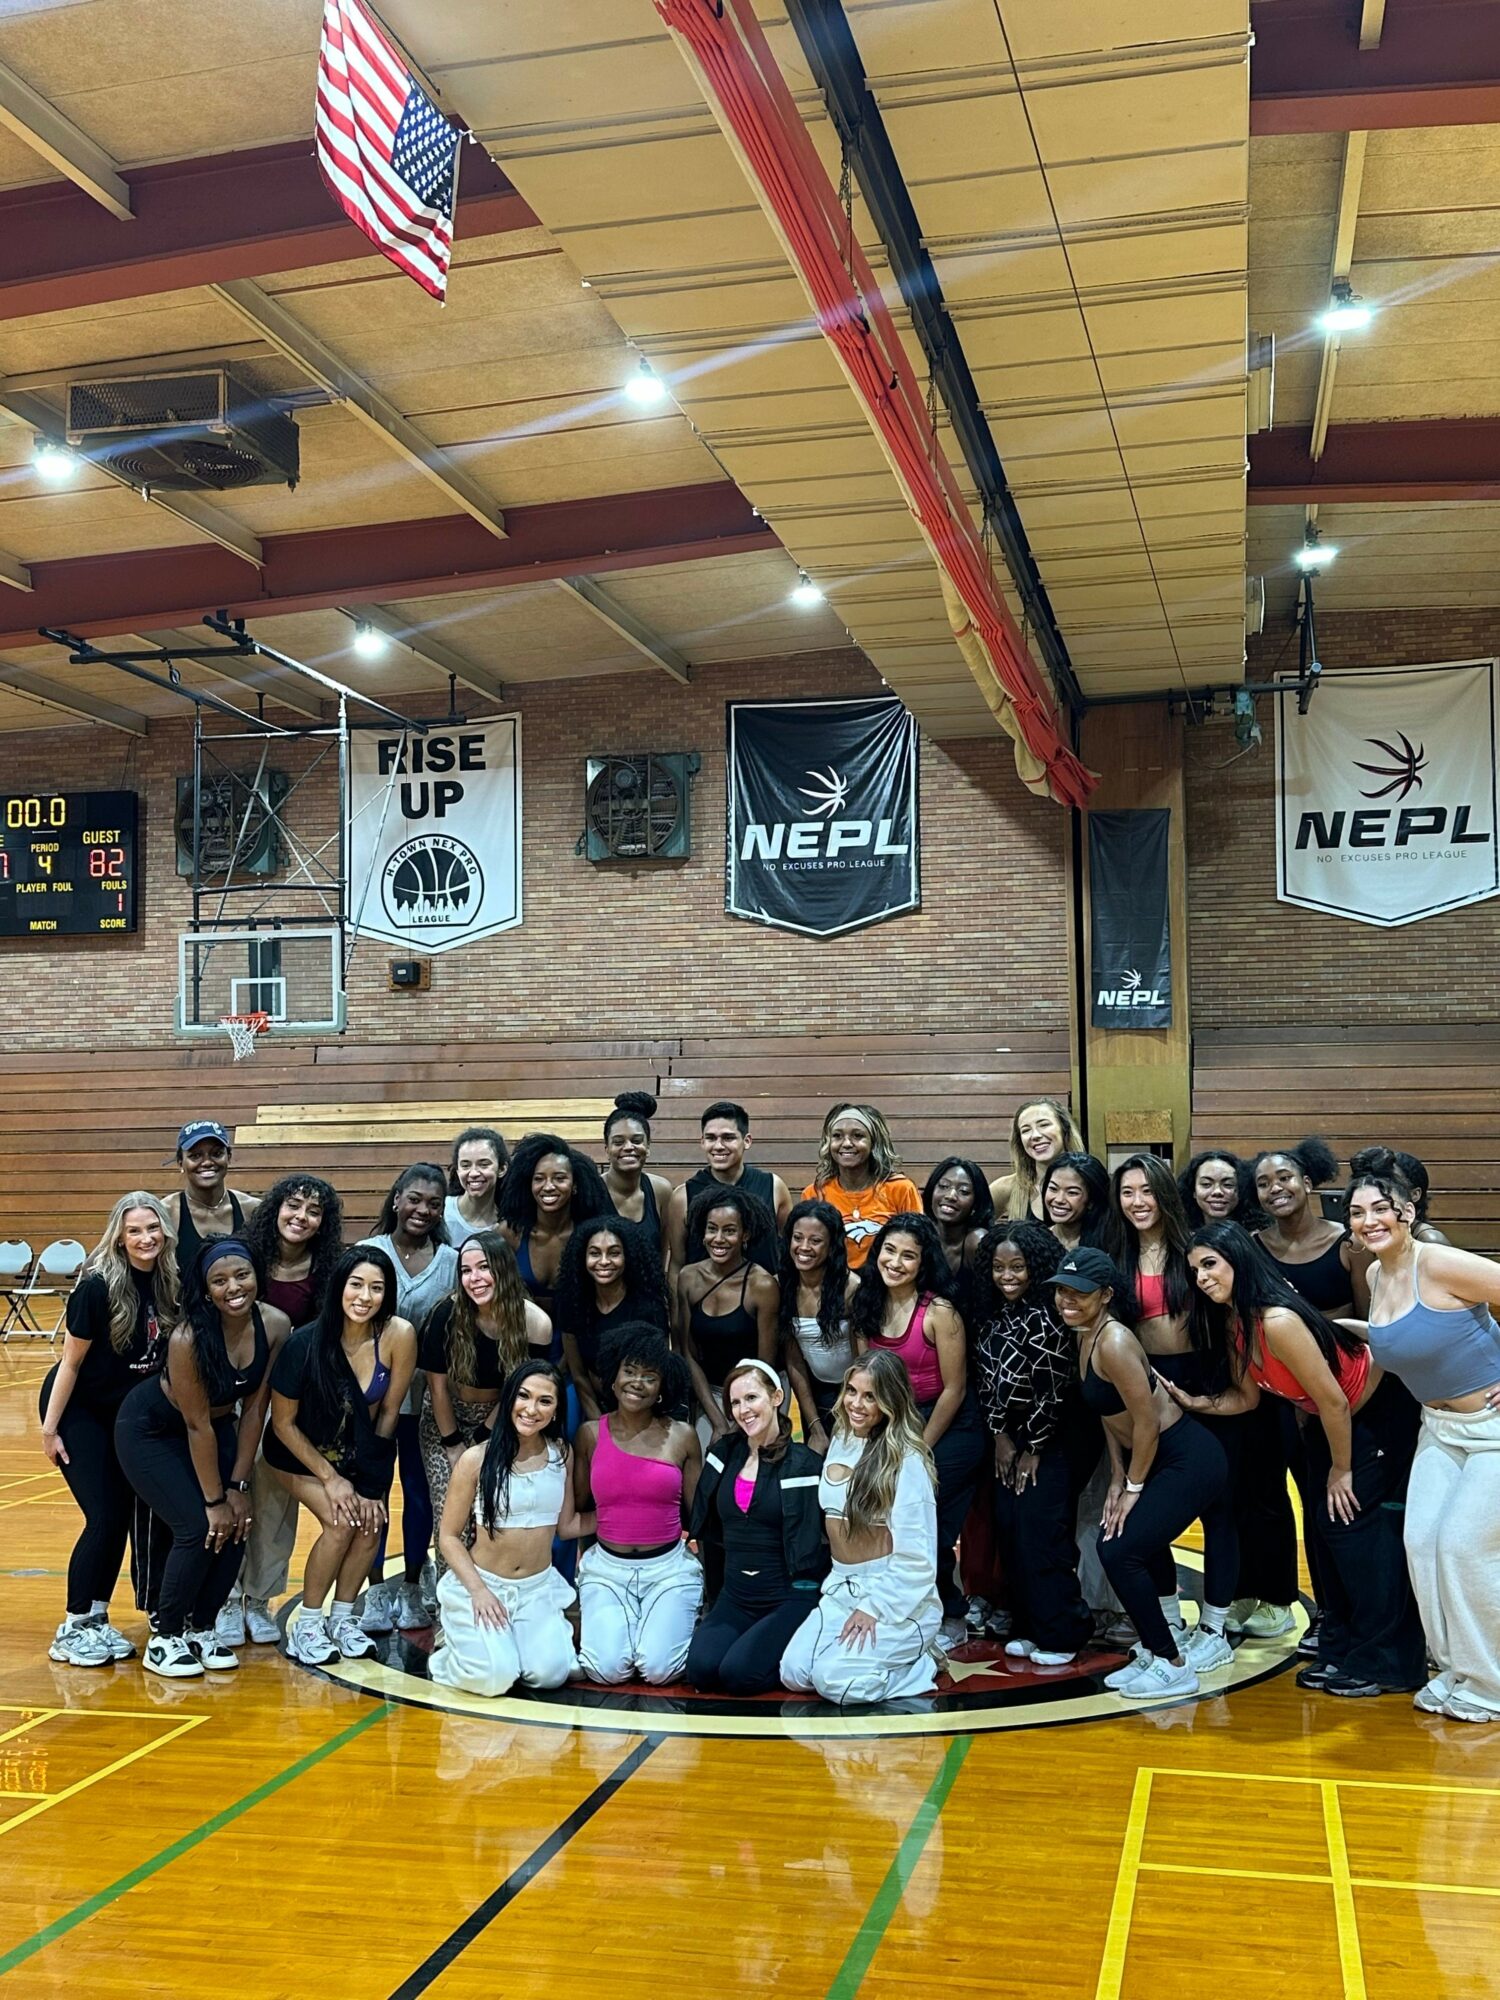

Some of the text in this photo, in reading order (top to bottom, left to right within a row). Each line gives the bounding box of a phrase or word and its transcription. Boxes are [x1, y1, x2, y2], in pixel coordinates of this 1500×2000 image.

[378, 735, 486, 776] RISE
[401, 781, 465, 820] UP
[1295, 805, 1491, 850] NEPL
[82, 830, 121, 845] GUEST
[740, 818, 909, 861] NEPL
[30, 842, 60, 853] PERIOD
[89, 848, 125, 877] 82
[386, 838, 477, 878] H-TOWN NEX PRO
[1316, 850, 1468, 863] NO EXCUSES PRO LEAGUE
[38, 855, 52, 875] 4
[762, 859, 886, 871] NO EXCUSES PRO LEAGUE
[15, 881, 74, 893] PLAYER FOUL
[101, 880, 128, 890] FOULS
[117, 892, 123, 912] 1
[30, 921, 57, 931] MATCH
[100, 918, 127, 929] SCORE
[412, 914, 451, 924] LEAGUE
[1097, 989, 1166, 1006] NEPL
